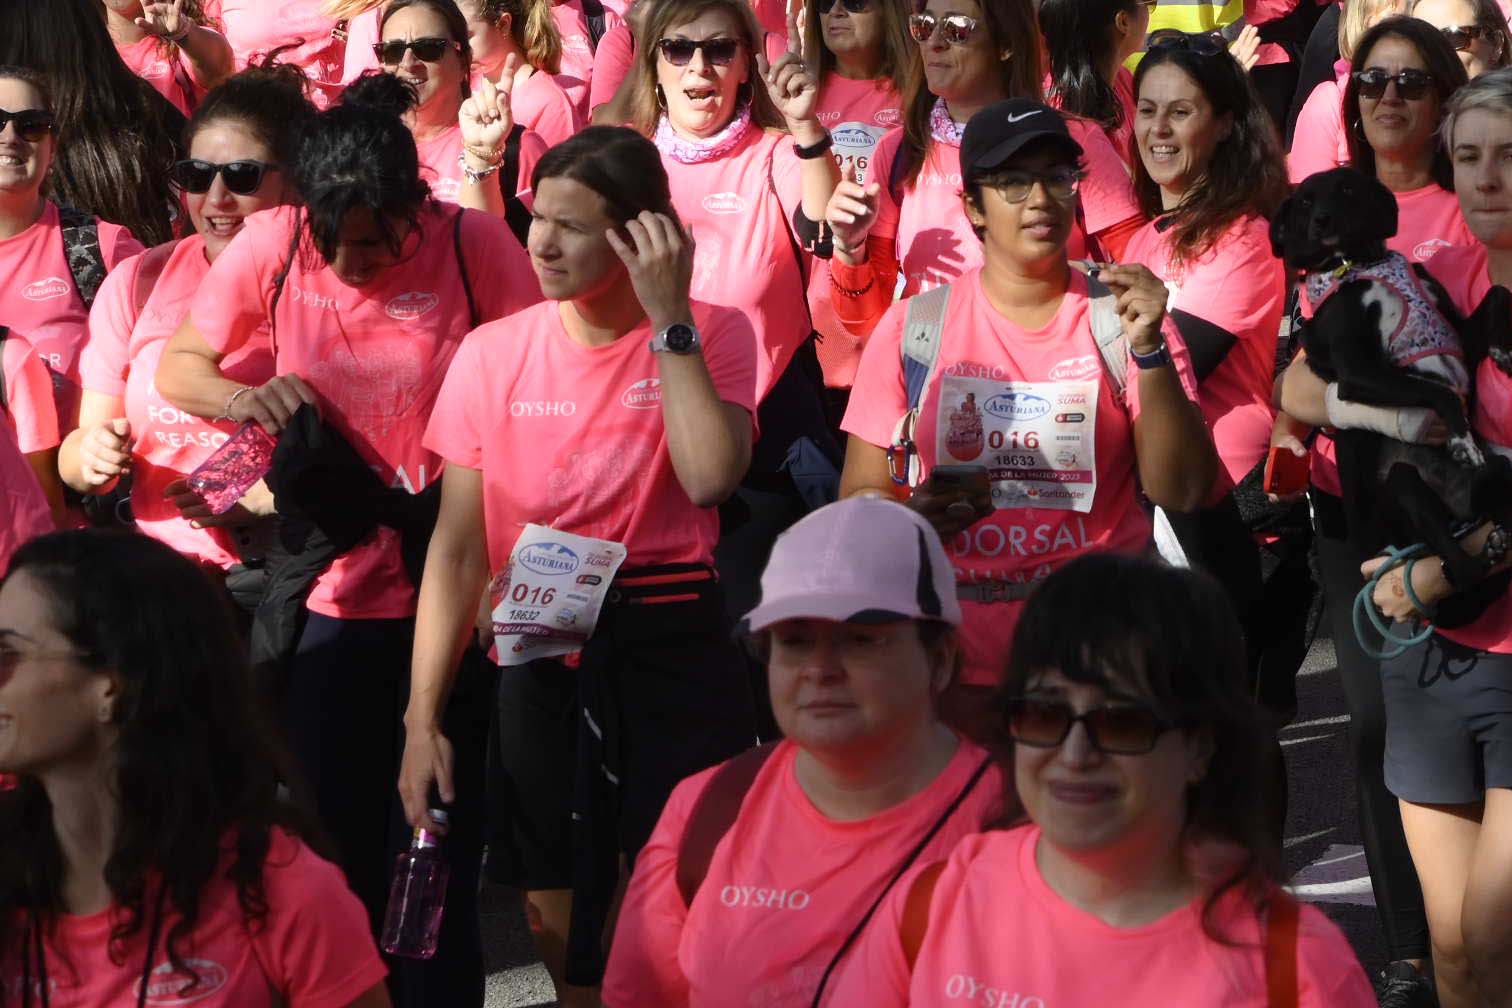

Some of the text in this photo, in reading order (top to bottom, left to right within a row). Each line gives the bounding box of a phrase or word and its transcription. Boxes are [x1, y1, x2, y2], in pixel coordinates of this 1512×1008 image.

[816, 111, 840, 121] SHO
[510, 400, 576, 417] OYSHO
[989, 398, 1047, 414] ASTURIANA
[988, 430, 1040, 450] 016
[995, 455, 1036, 467] 18633
[1039, 488, 1086, 499] Santander
[524, 551, 576, 573] ASTURIANA
[511, 583, 556, 608] 016
[508, 609, 541, 621] 18632
[720, 885, 811, 911] OYSHO
